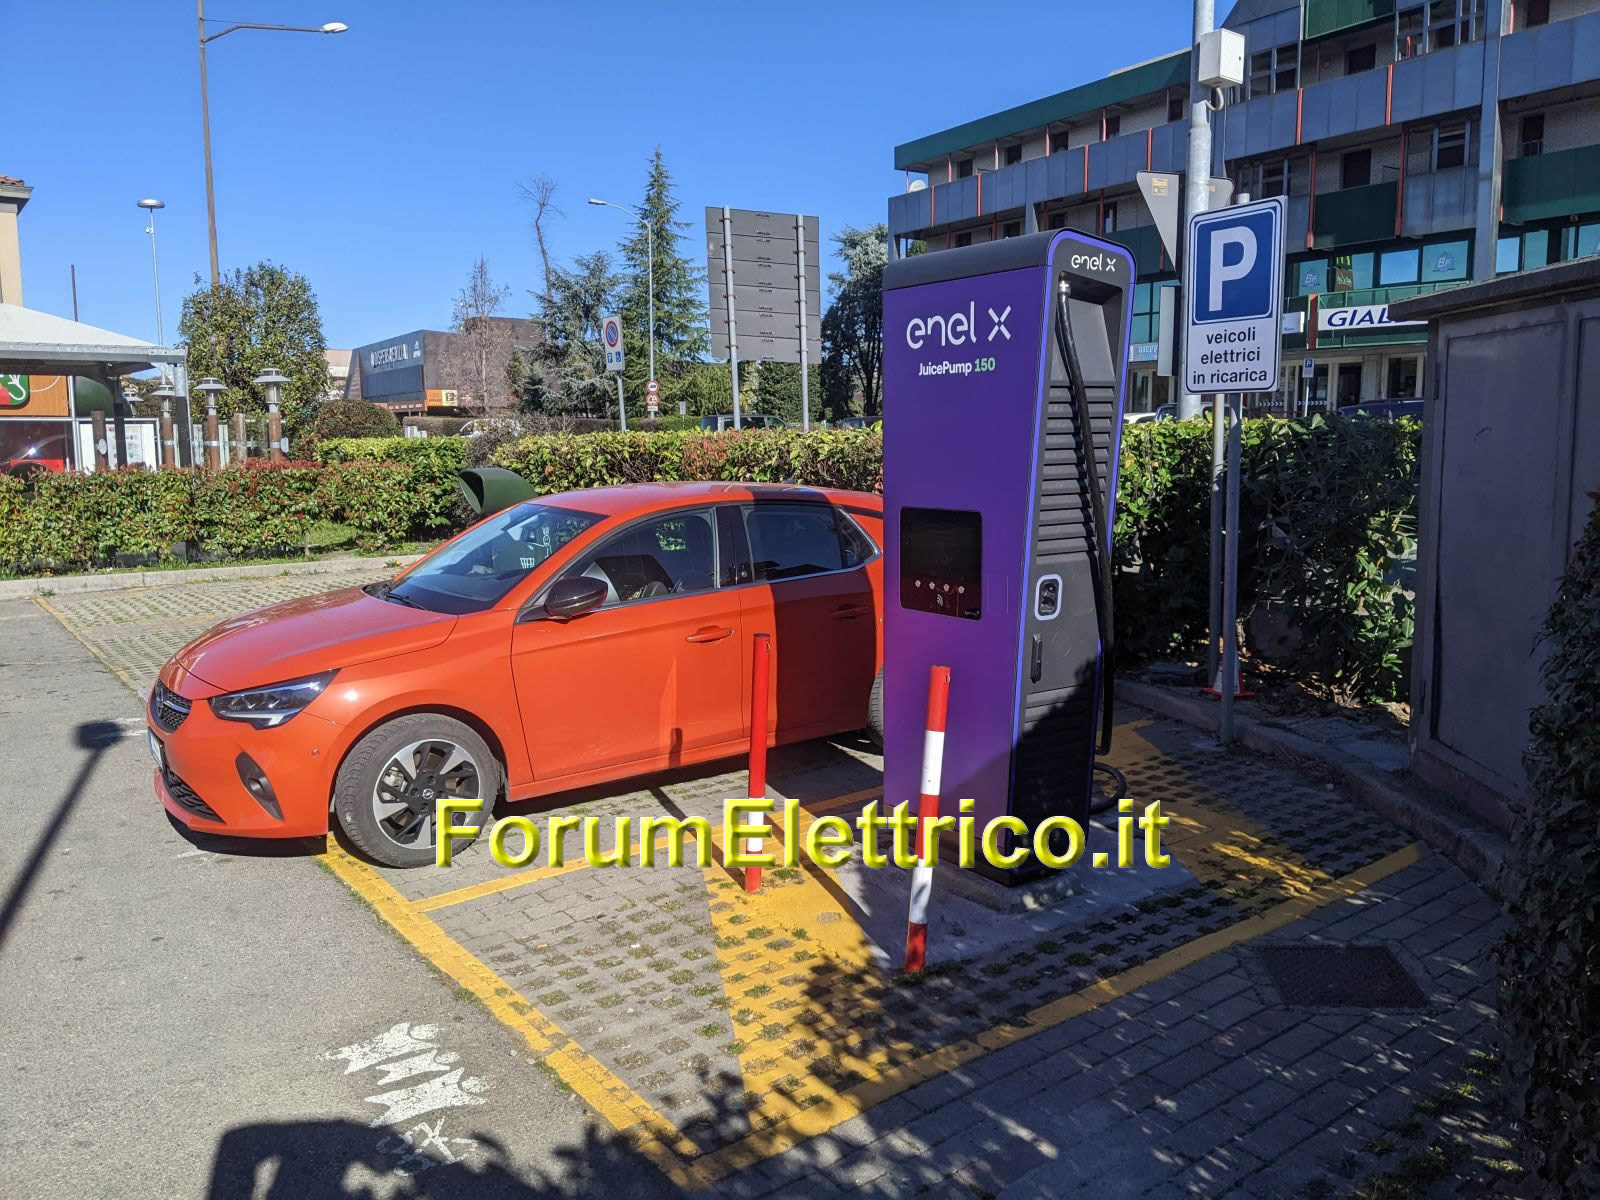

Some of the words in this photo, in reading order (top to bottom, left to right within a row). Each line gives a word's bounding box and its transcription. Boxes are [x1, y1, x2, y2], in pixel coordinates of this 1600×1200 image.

[1071, 253, 1103, 272] enel
[1209, 226, 1257, 312] P
[906, 300, 977, 350] enel
[1327, 307, 1405, 327] GIAL
[1206, 326, 1256, 345] veicoli
[1200, 346, 1261, 365] elettrici
[918, 360, 972, 377] JuicePump
[974, 356, 996, 372] 150
[1193, 370, 1205, 385] in
[1210, 367, 1267, 384] ricarica
